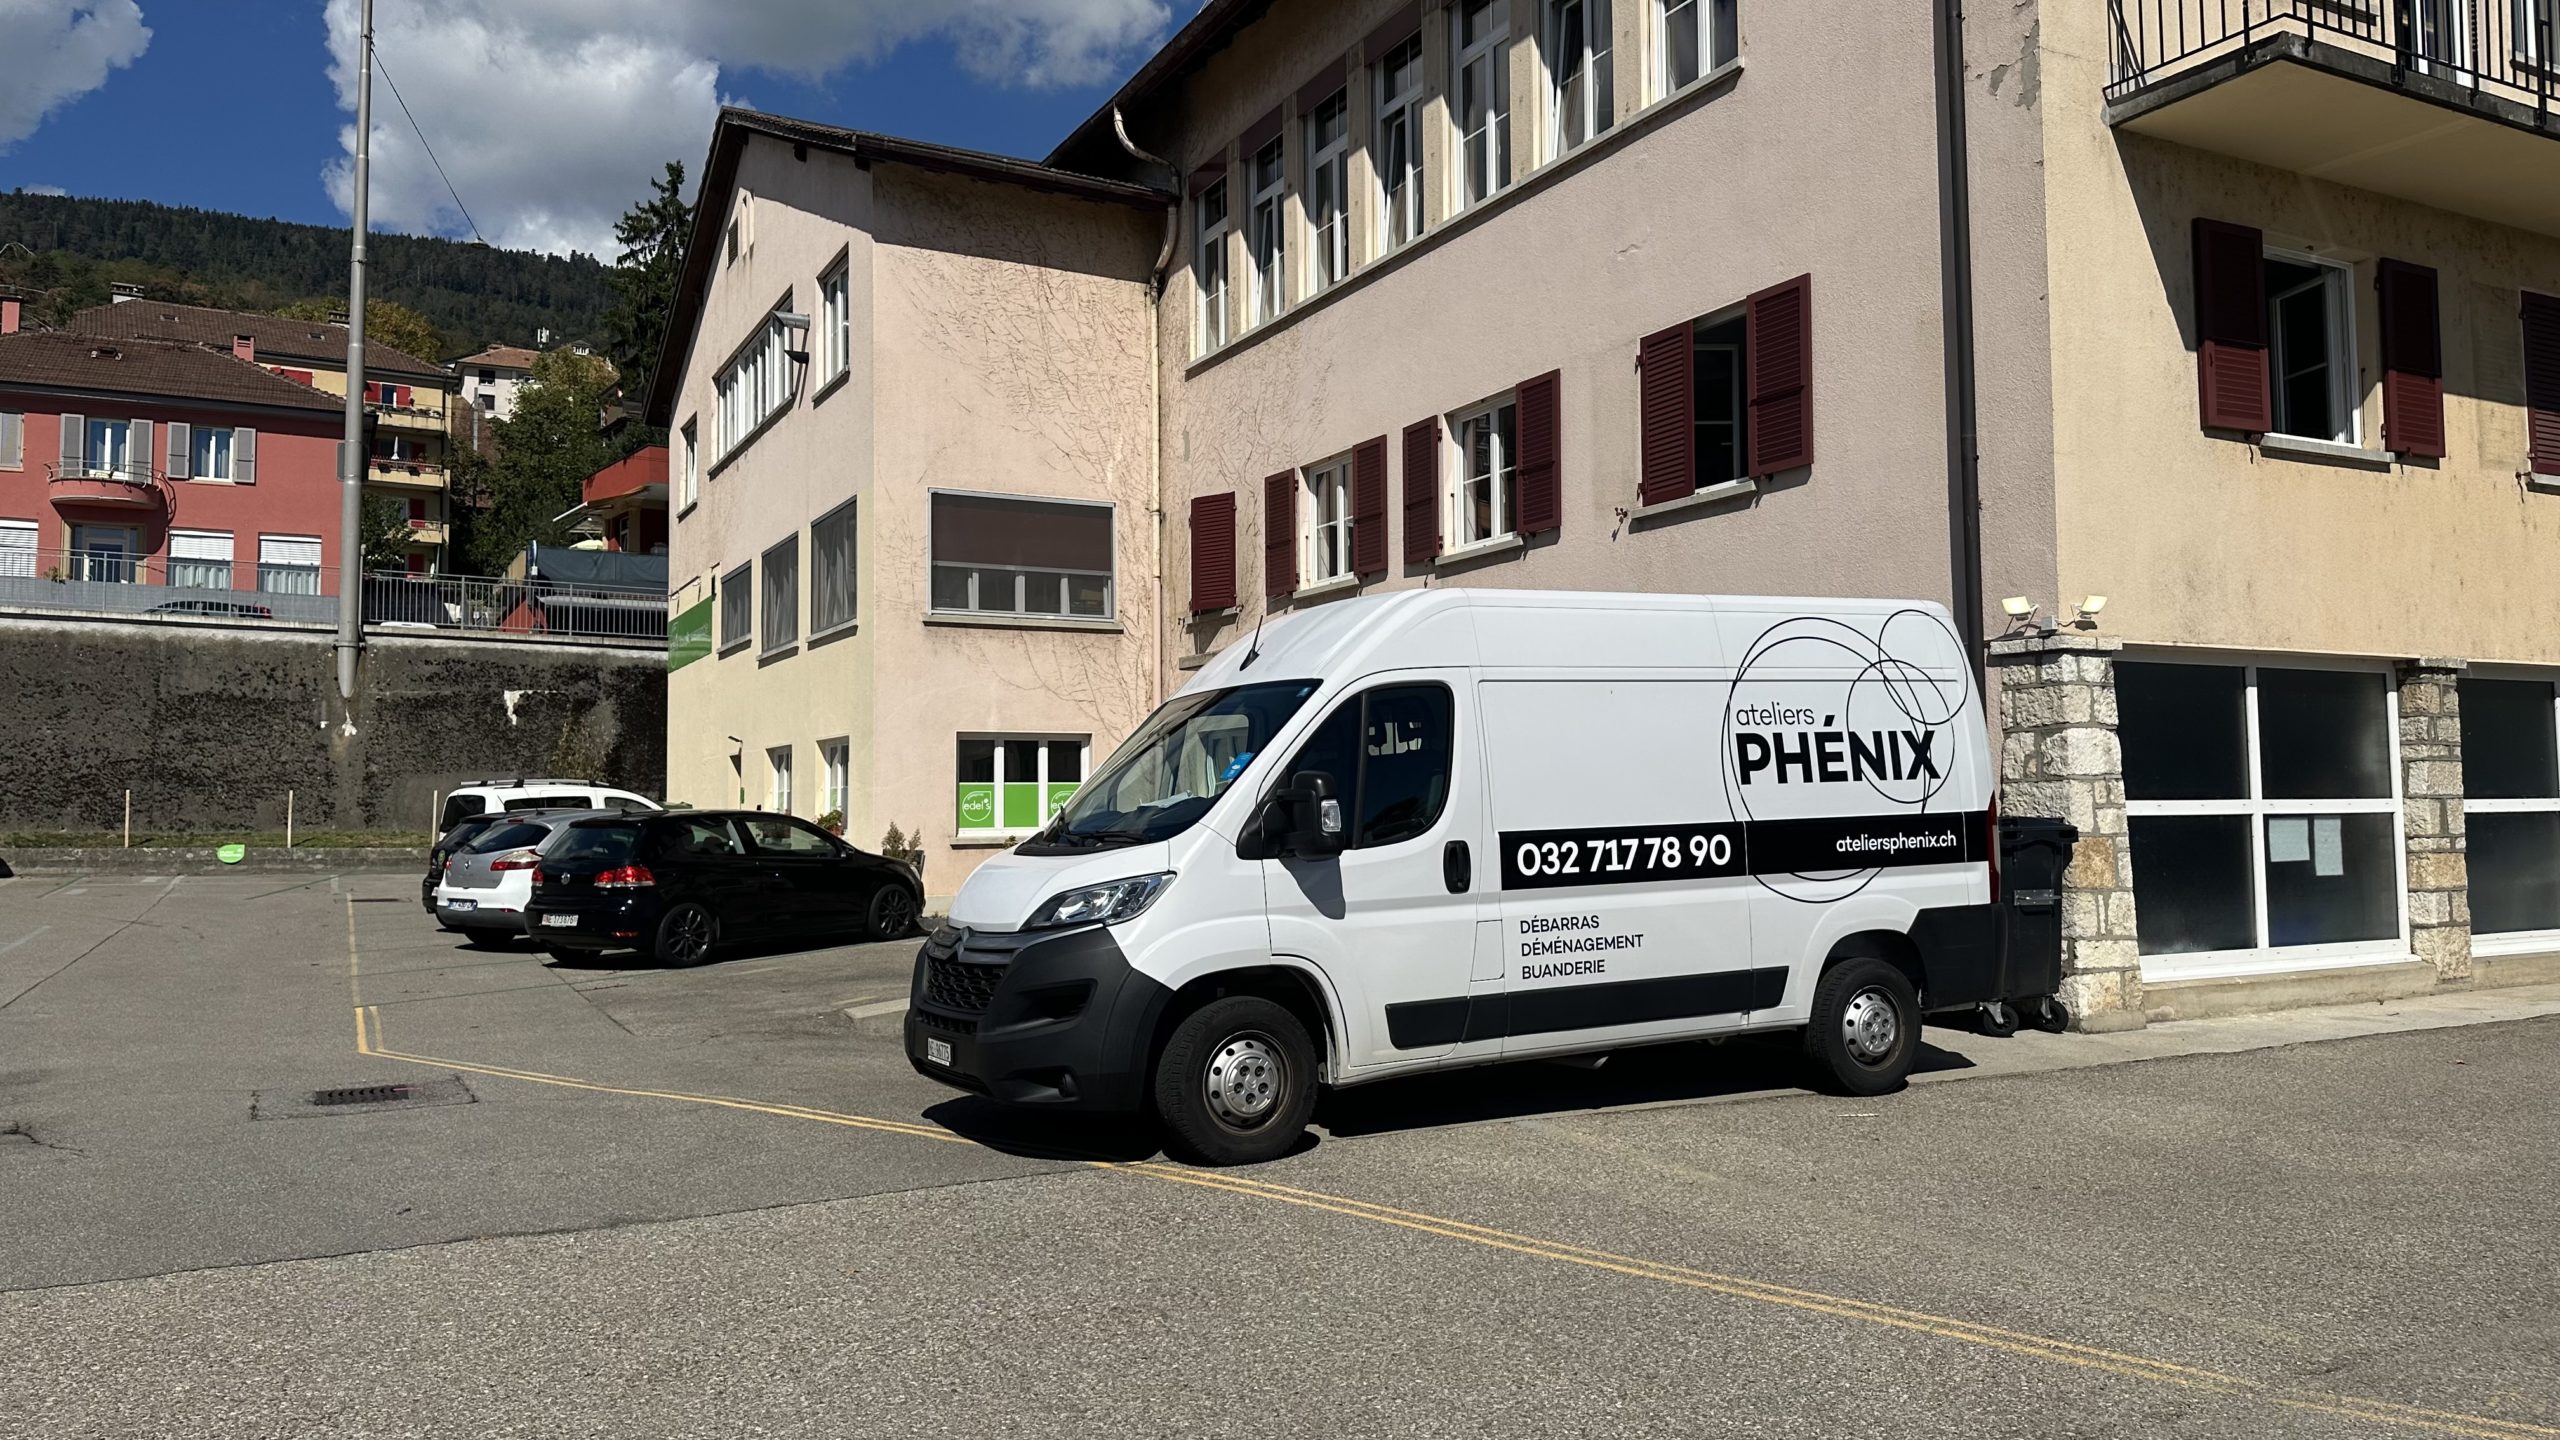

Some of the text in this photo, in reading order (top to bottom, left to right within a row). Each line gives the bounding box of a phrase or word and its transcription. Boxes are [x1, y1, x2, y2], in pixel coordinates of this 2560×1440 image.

[1736, 702, 1815, 726] ateliers
[1735, 715, 1941, 785] PHÉNIX
[1836, 829, 1957, 855] ateliersphenix.ch
[1517, 833, 1731, 877] 032 717 78 90
[1519, 914, 1600, 934] DÉBARRAS
[1521, 934, 1644, 957] DÉMÉNAGEMENT
[1522, 959, 1606, 980] BUANDERIE
